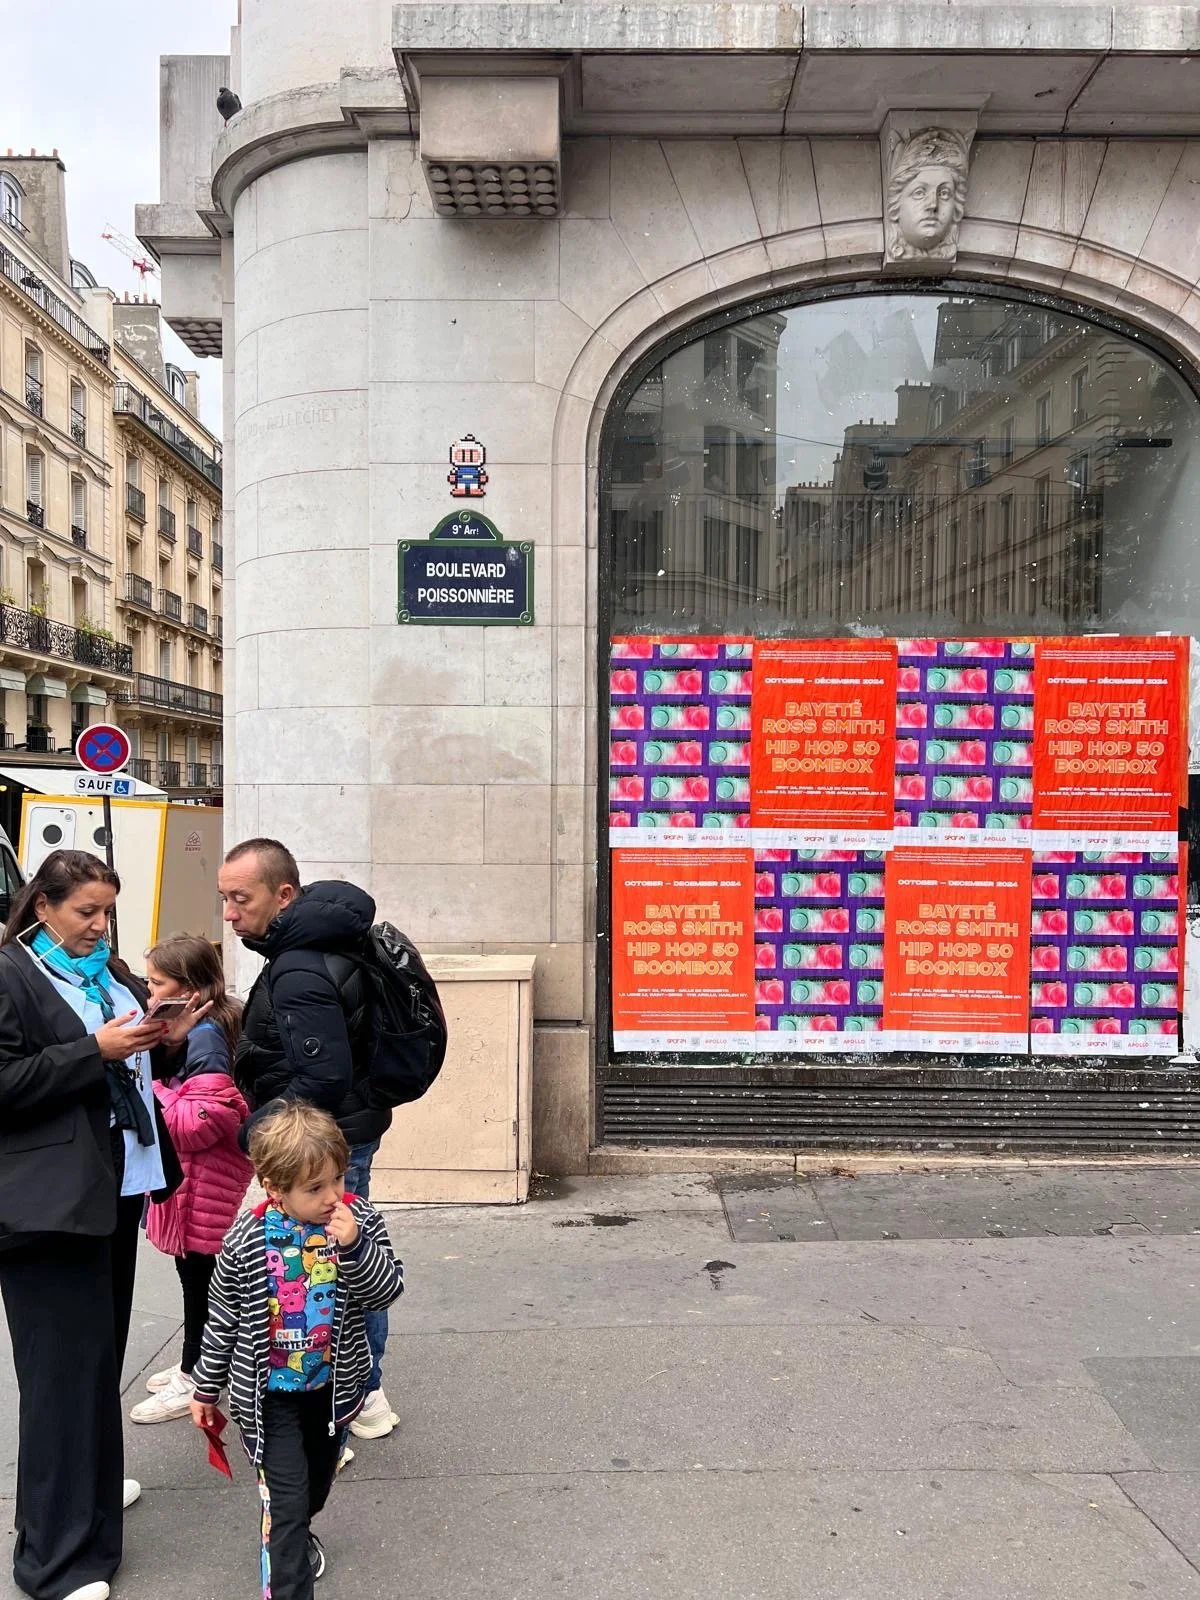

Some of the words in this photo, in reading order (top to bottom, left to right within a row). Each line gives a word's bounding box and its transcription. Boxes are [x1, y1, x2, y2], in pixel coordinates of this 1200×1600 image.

[426, 562, 506, 578] BOULEVARD
[417, 585, 515, 604] POISSONNIÈRE
[814, 676, 860, 685] DÉCEMBRE
[1098, 676, 1144, 685] DÉCEMBRE
[785, 699, 862, 717] BAYETÉ
[1068, 699, 1146, 717] BAYETÉ
[762, 719, 817, 734] ROSS
[822, 719, 885, 735] SMITH
[1045, 719, 1100, 734] ROSS
[1106, 720, 1168, 735] SMITH
[766, 740, 800, 755] HIP
[805, 740, 848, 755] HOP
[853, 741, 880, 756] 50
[1049, 740, 1083, 755] HIP
[1088, 741, 1131, 756] HOP
[1137, 742, 1164, 756] 50
[772, 758, 873, 773] BOOMBOX
[1055, 759, 1157, 774] BOOMBOX
[78, 778, 113, 791] SAUF
[948, 879, 994, 887] DECEMBER
[645, 901, 720, 919] BAYETÉ
[919, 902, 996, 919] BAYETÉ
[624, 921, 677, 936] ROSS
[682, 921, 743, 936] SMITH
[896, 920, 951, 935] ROSS
[956, 921, 1018, 937] SMITH
[627, 942, 661, 956] HIP
[665, 942, 707, 957] HOP
[712, 942, 739, 957] 50
[900, 942, 934, 956] HIP
[938, 942, 982, 957] HOP
[987, 943, 1014, 958] 50
[634, 960, 733, 975] BOOMBOX
[906, 959, 1007, 976] BOOMBOX
